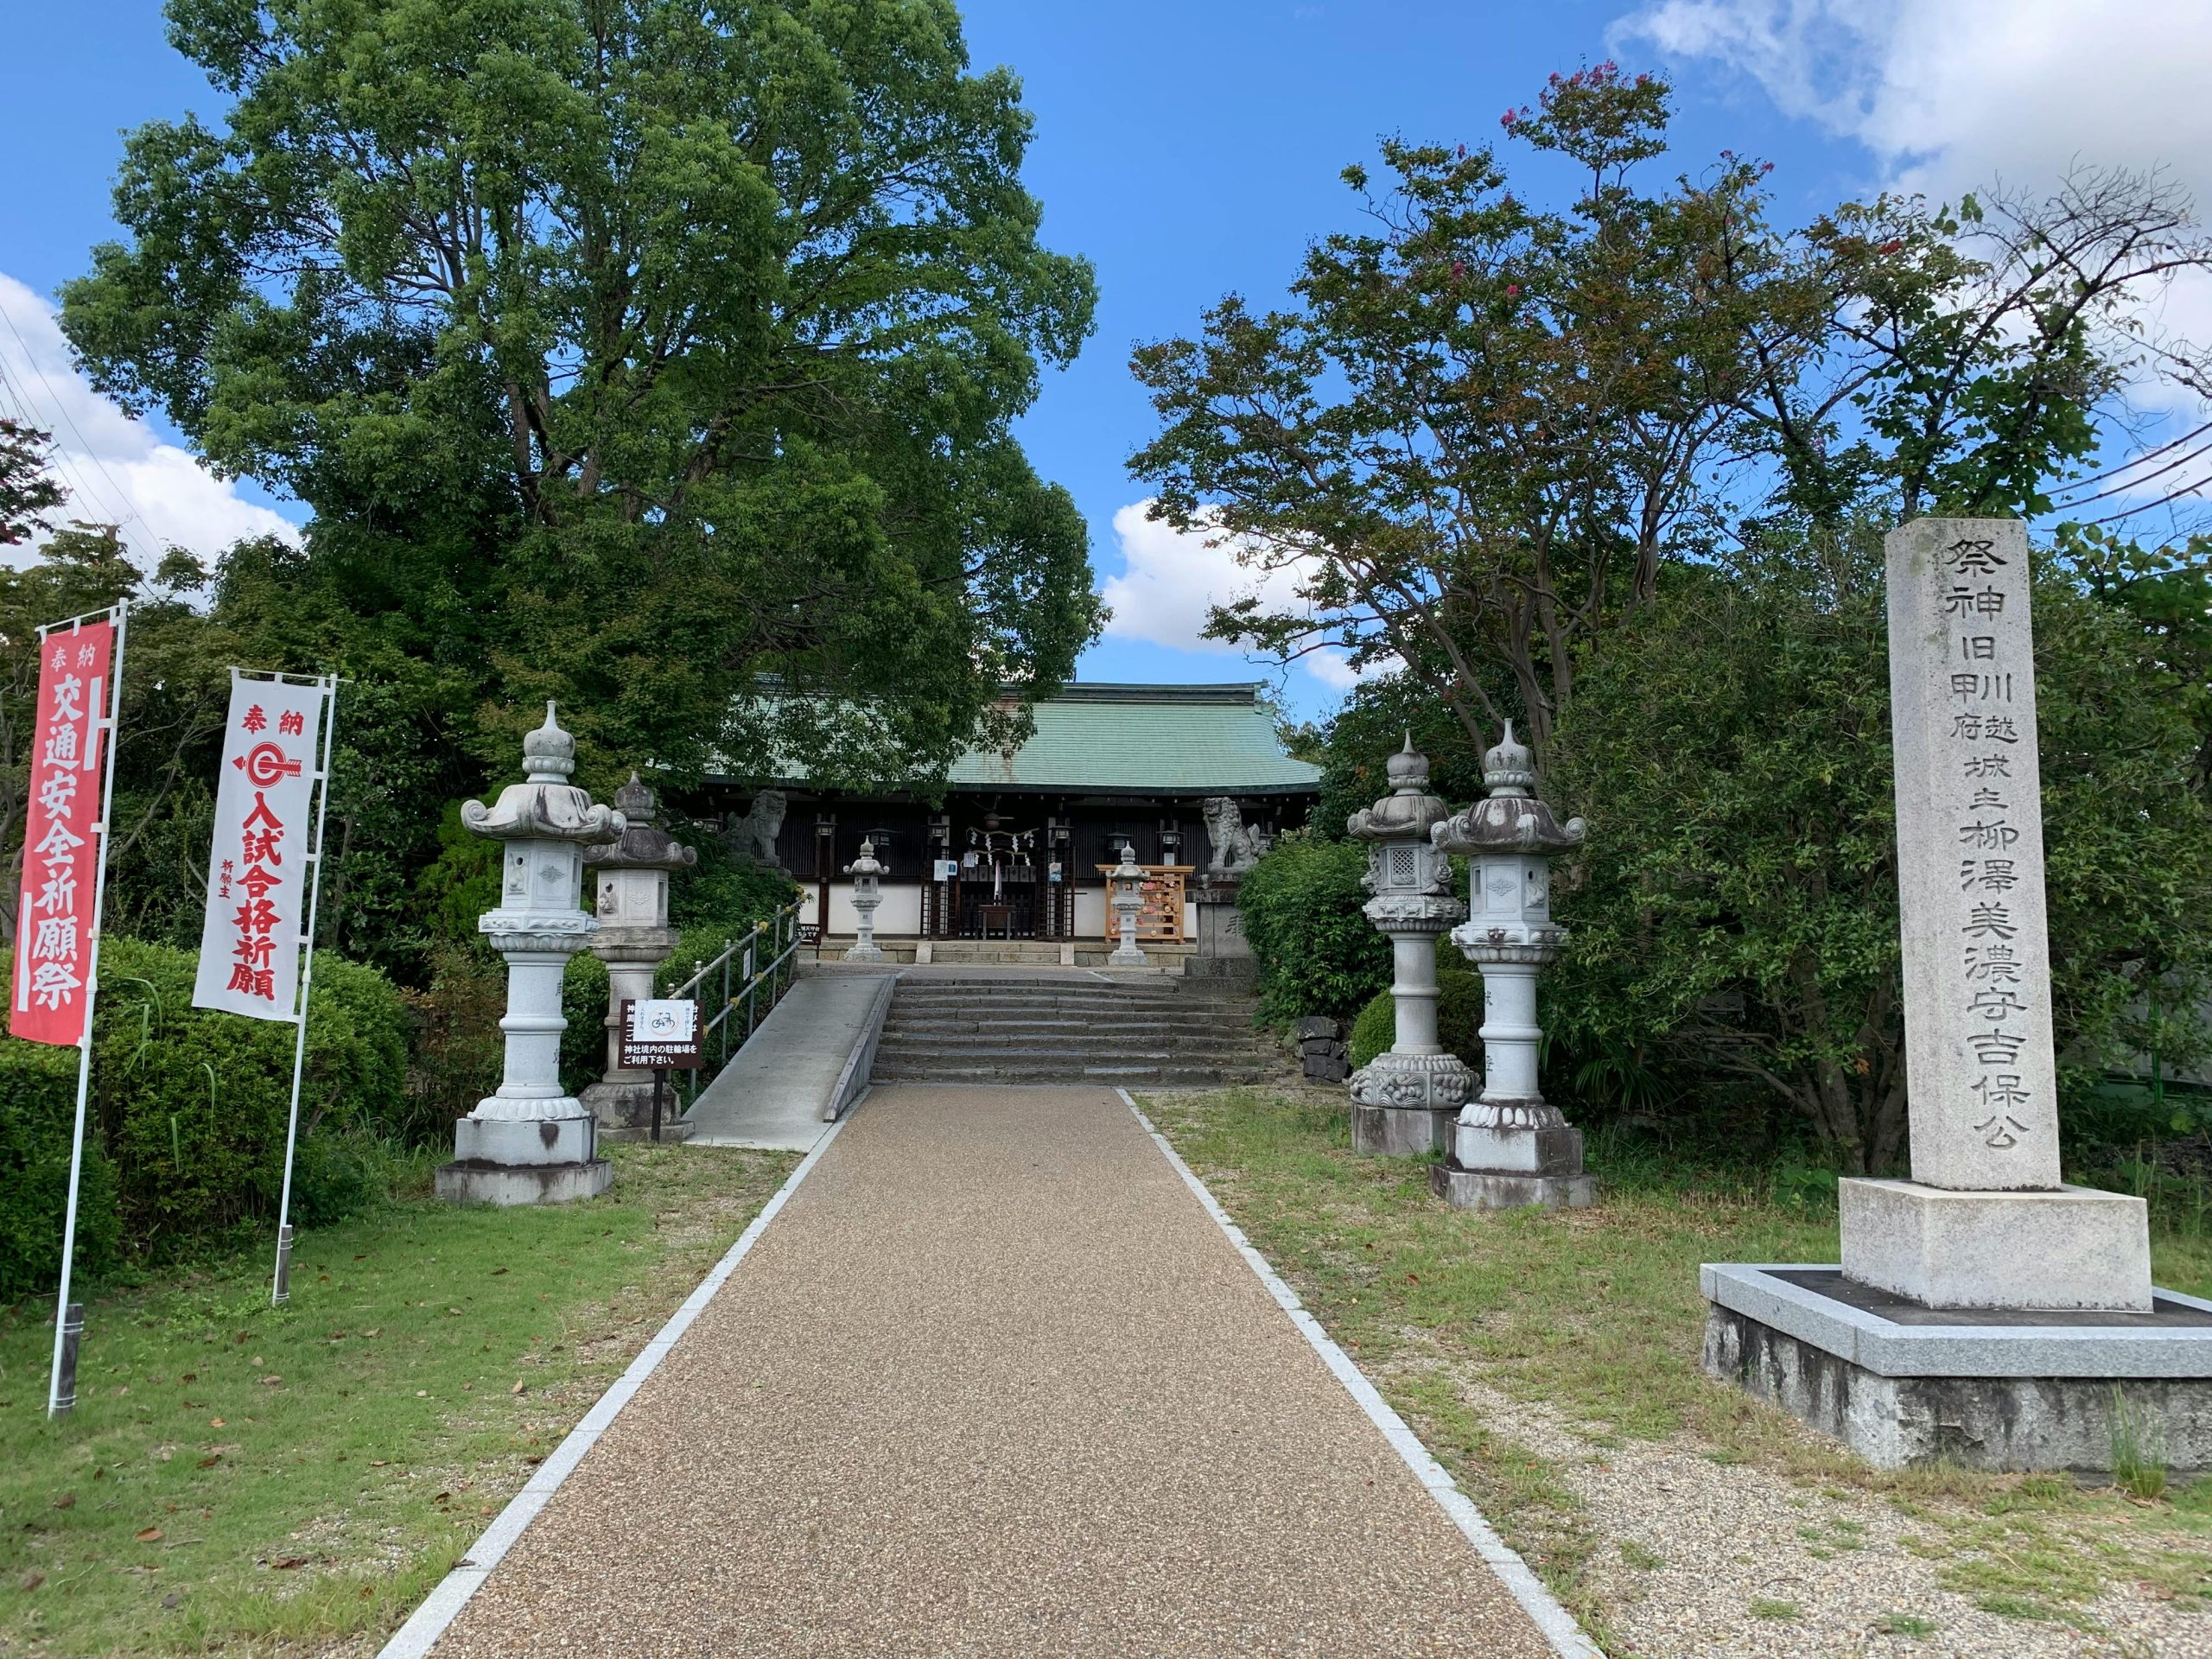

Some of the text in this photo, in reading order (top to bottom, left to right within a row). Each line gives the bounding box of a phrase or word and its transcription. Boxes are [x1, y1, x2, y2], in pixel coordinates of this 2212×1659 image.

[49, 643, 97, 672] 奉納
[240, 704, 305, 736] 奉納
[31, 672, 85, 1011] 交通安全祈願祭
[218, 858, 234, 899] 祈願主
[226, 791, 284, 1001] 入試合格祈願
[623, 1055, 675, 1065] ご利用下さい。
[624, 1045, 697, 1054] 神社境内の駐輪場を
